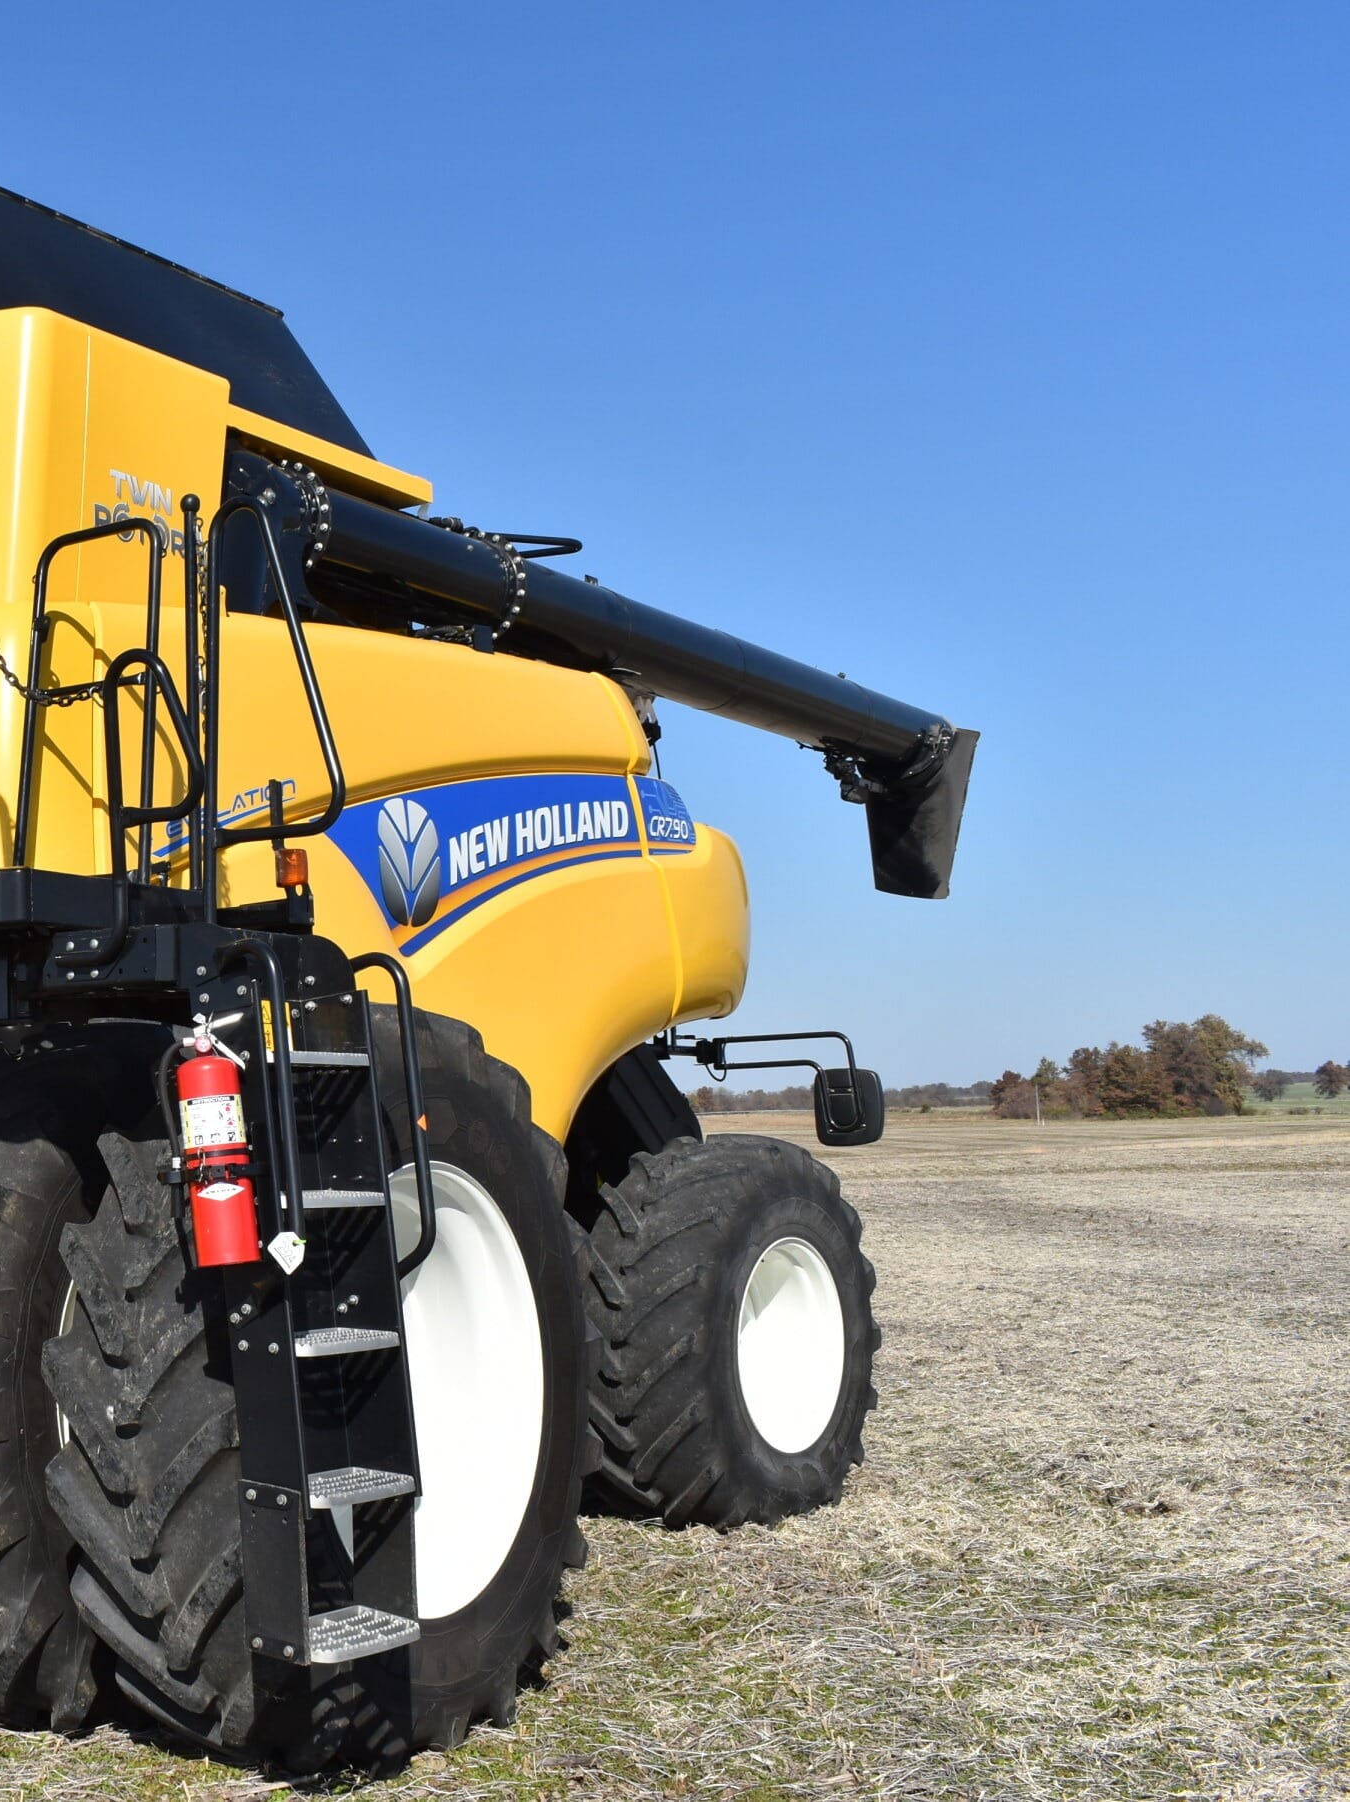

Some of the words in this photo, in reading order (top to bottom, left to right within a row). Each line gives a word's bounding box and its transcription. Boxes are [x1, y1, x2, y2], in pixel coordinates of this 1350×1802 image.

[110, 468, 171, 516] TWIN
[449, 816, 510, 887] NEW
[515, 800, 629, 857] HOLLAND
[649, 815, 689, 840] CR7.90
